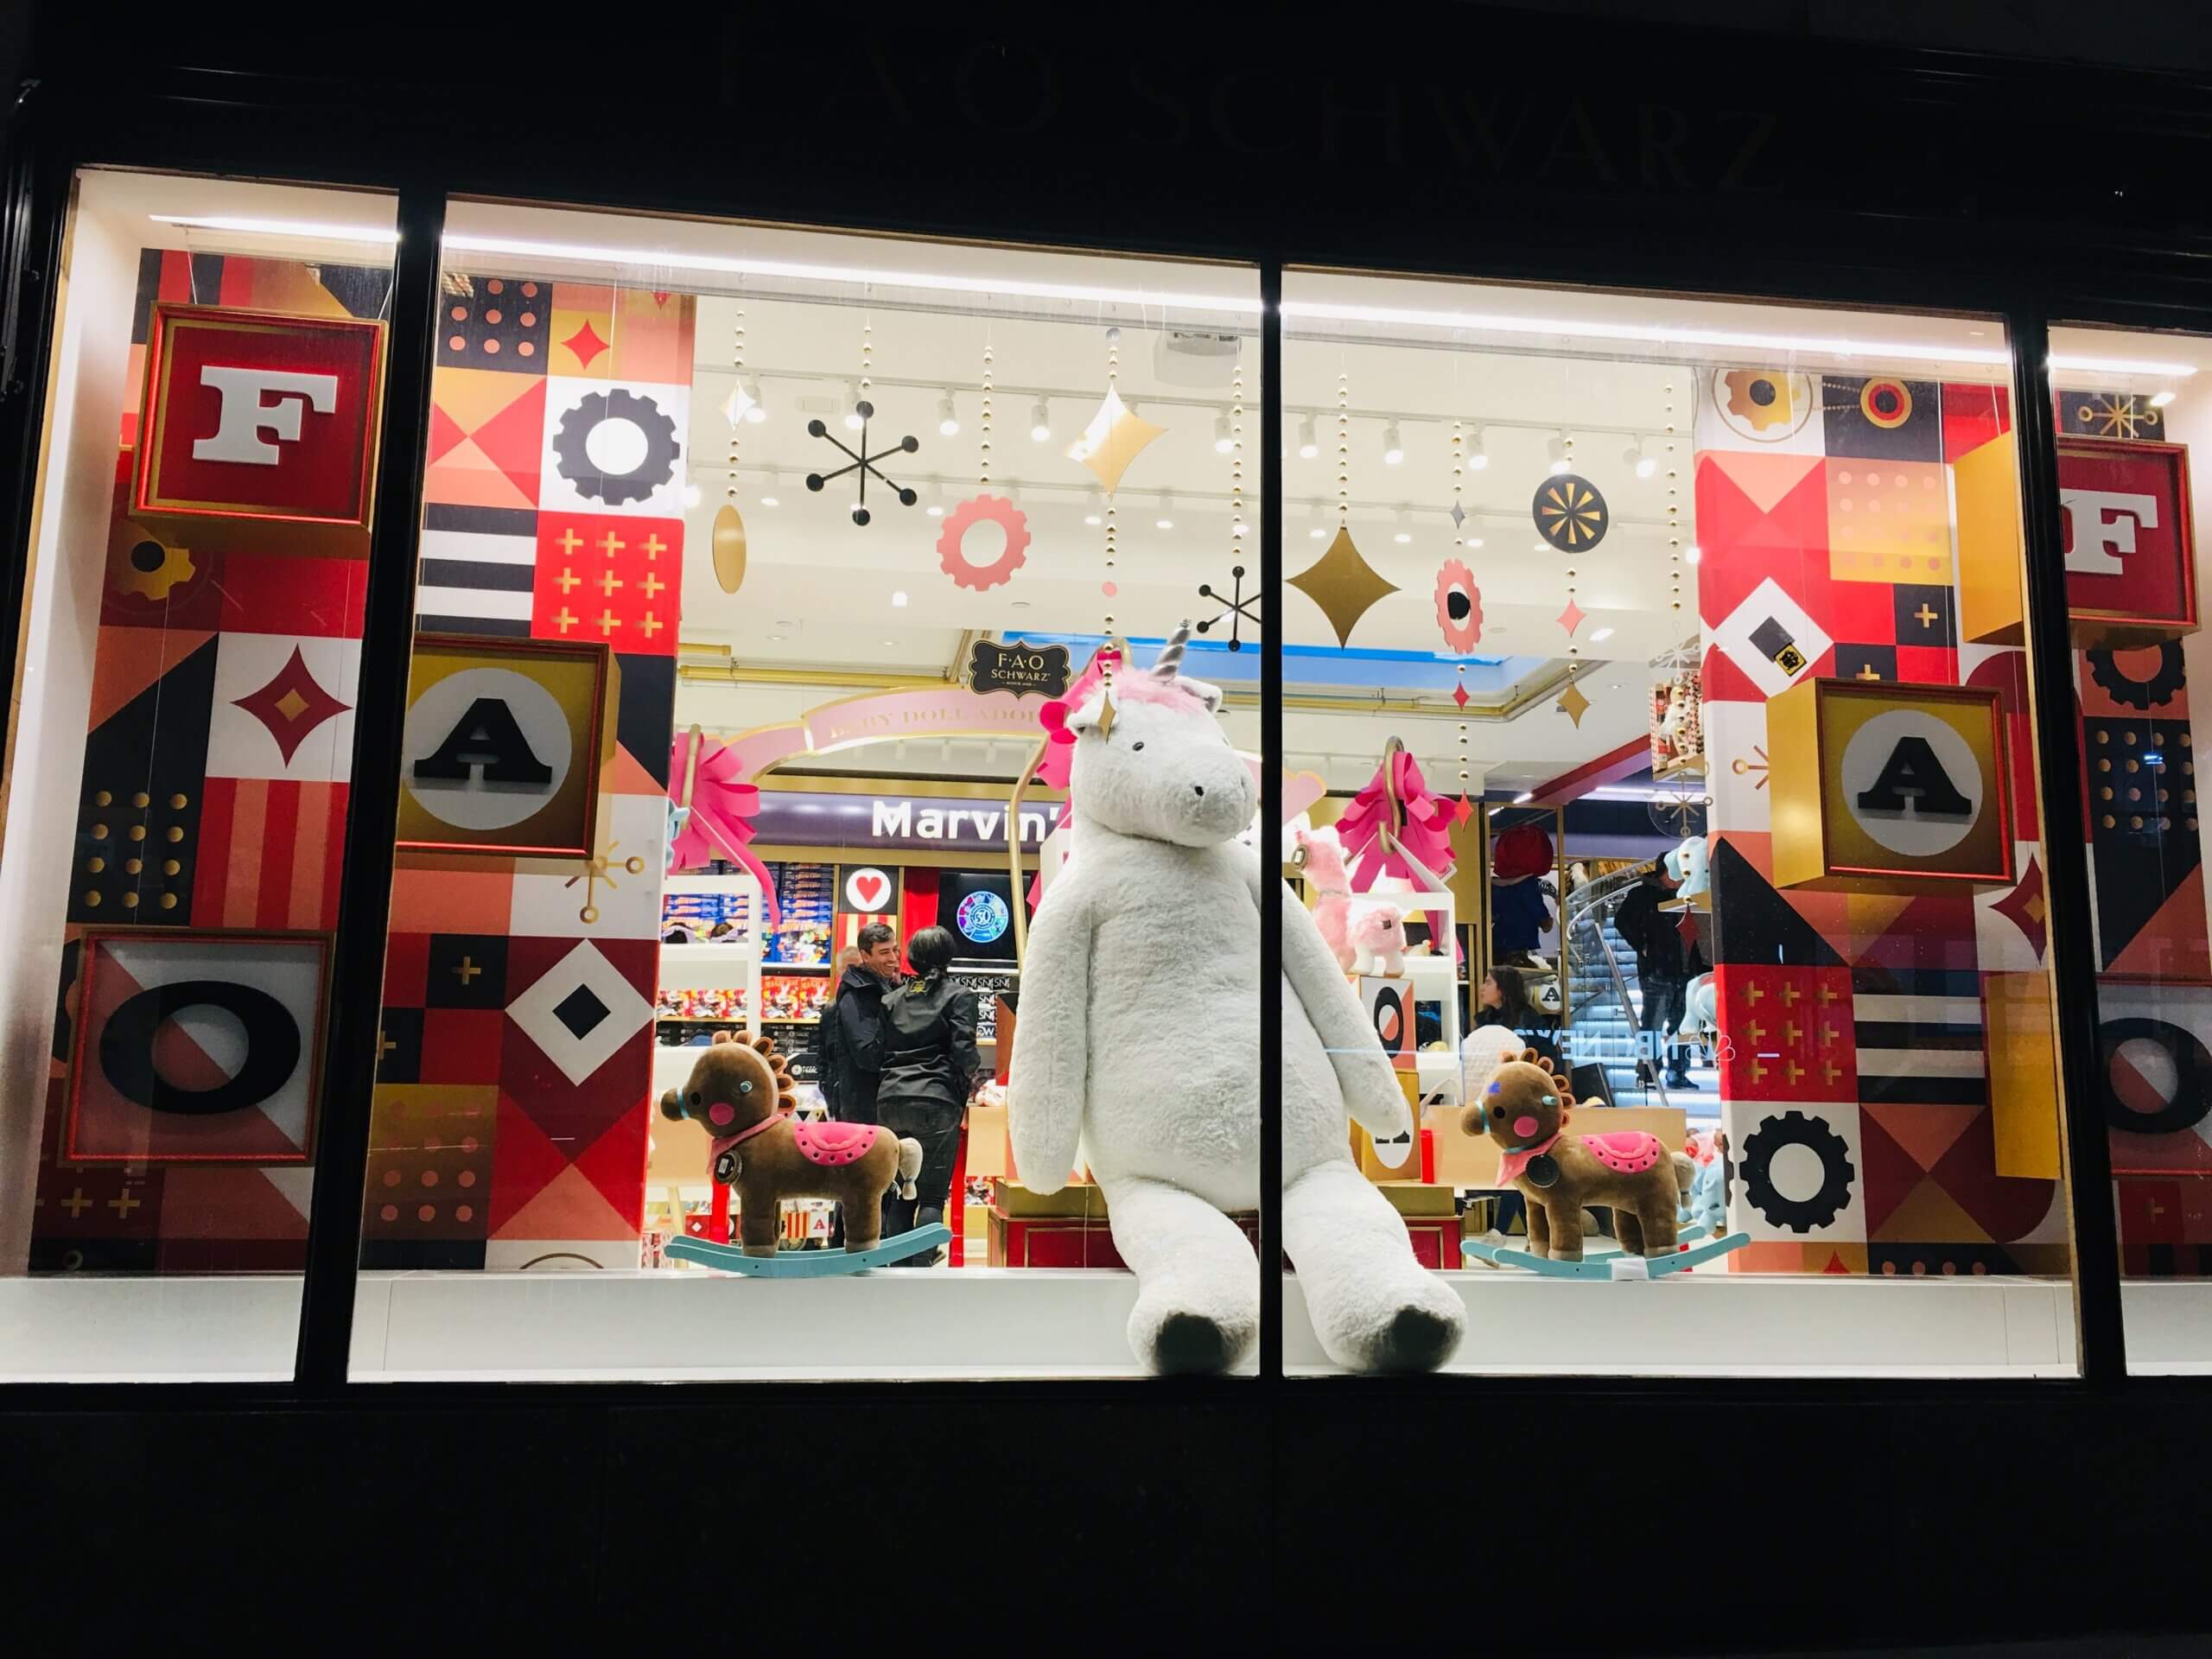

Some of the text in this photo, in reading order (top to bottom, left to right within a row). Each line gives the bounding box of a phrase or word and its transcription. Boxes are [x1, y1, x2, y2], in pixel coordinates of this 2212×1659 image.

[1127, 60, 1785, 194] SCHWARZ
[193, 365, 338, 466] F
[2061, 488, 2158, 575] F
[412, 697, 553, 784] A
[1857, 736, 1973, 816] A
[1374, 987, 1404, 1059] O
[1541, 987, 1560, 1002] A
[99, 981, 301, 1115] O
